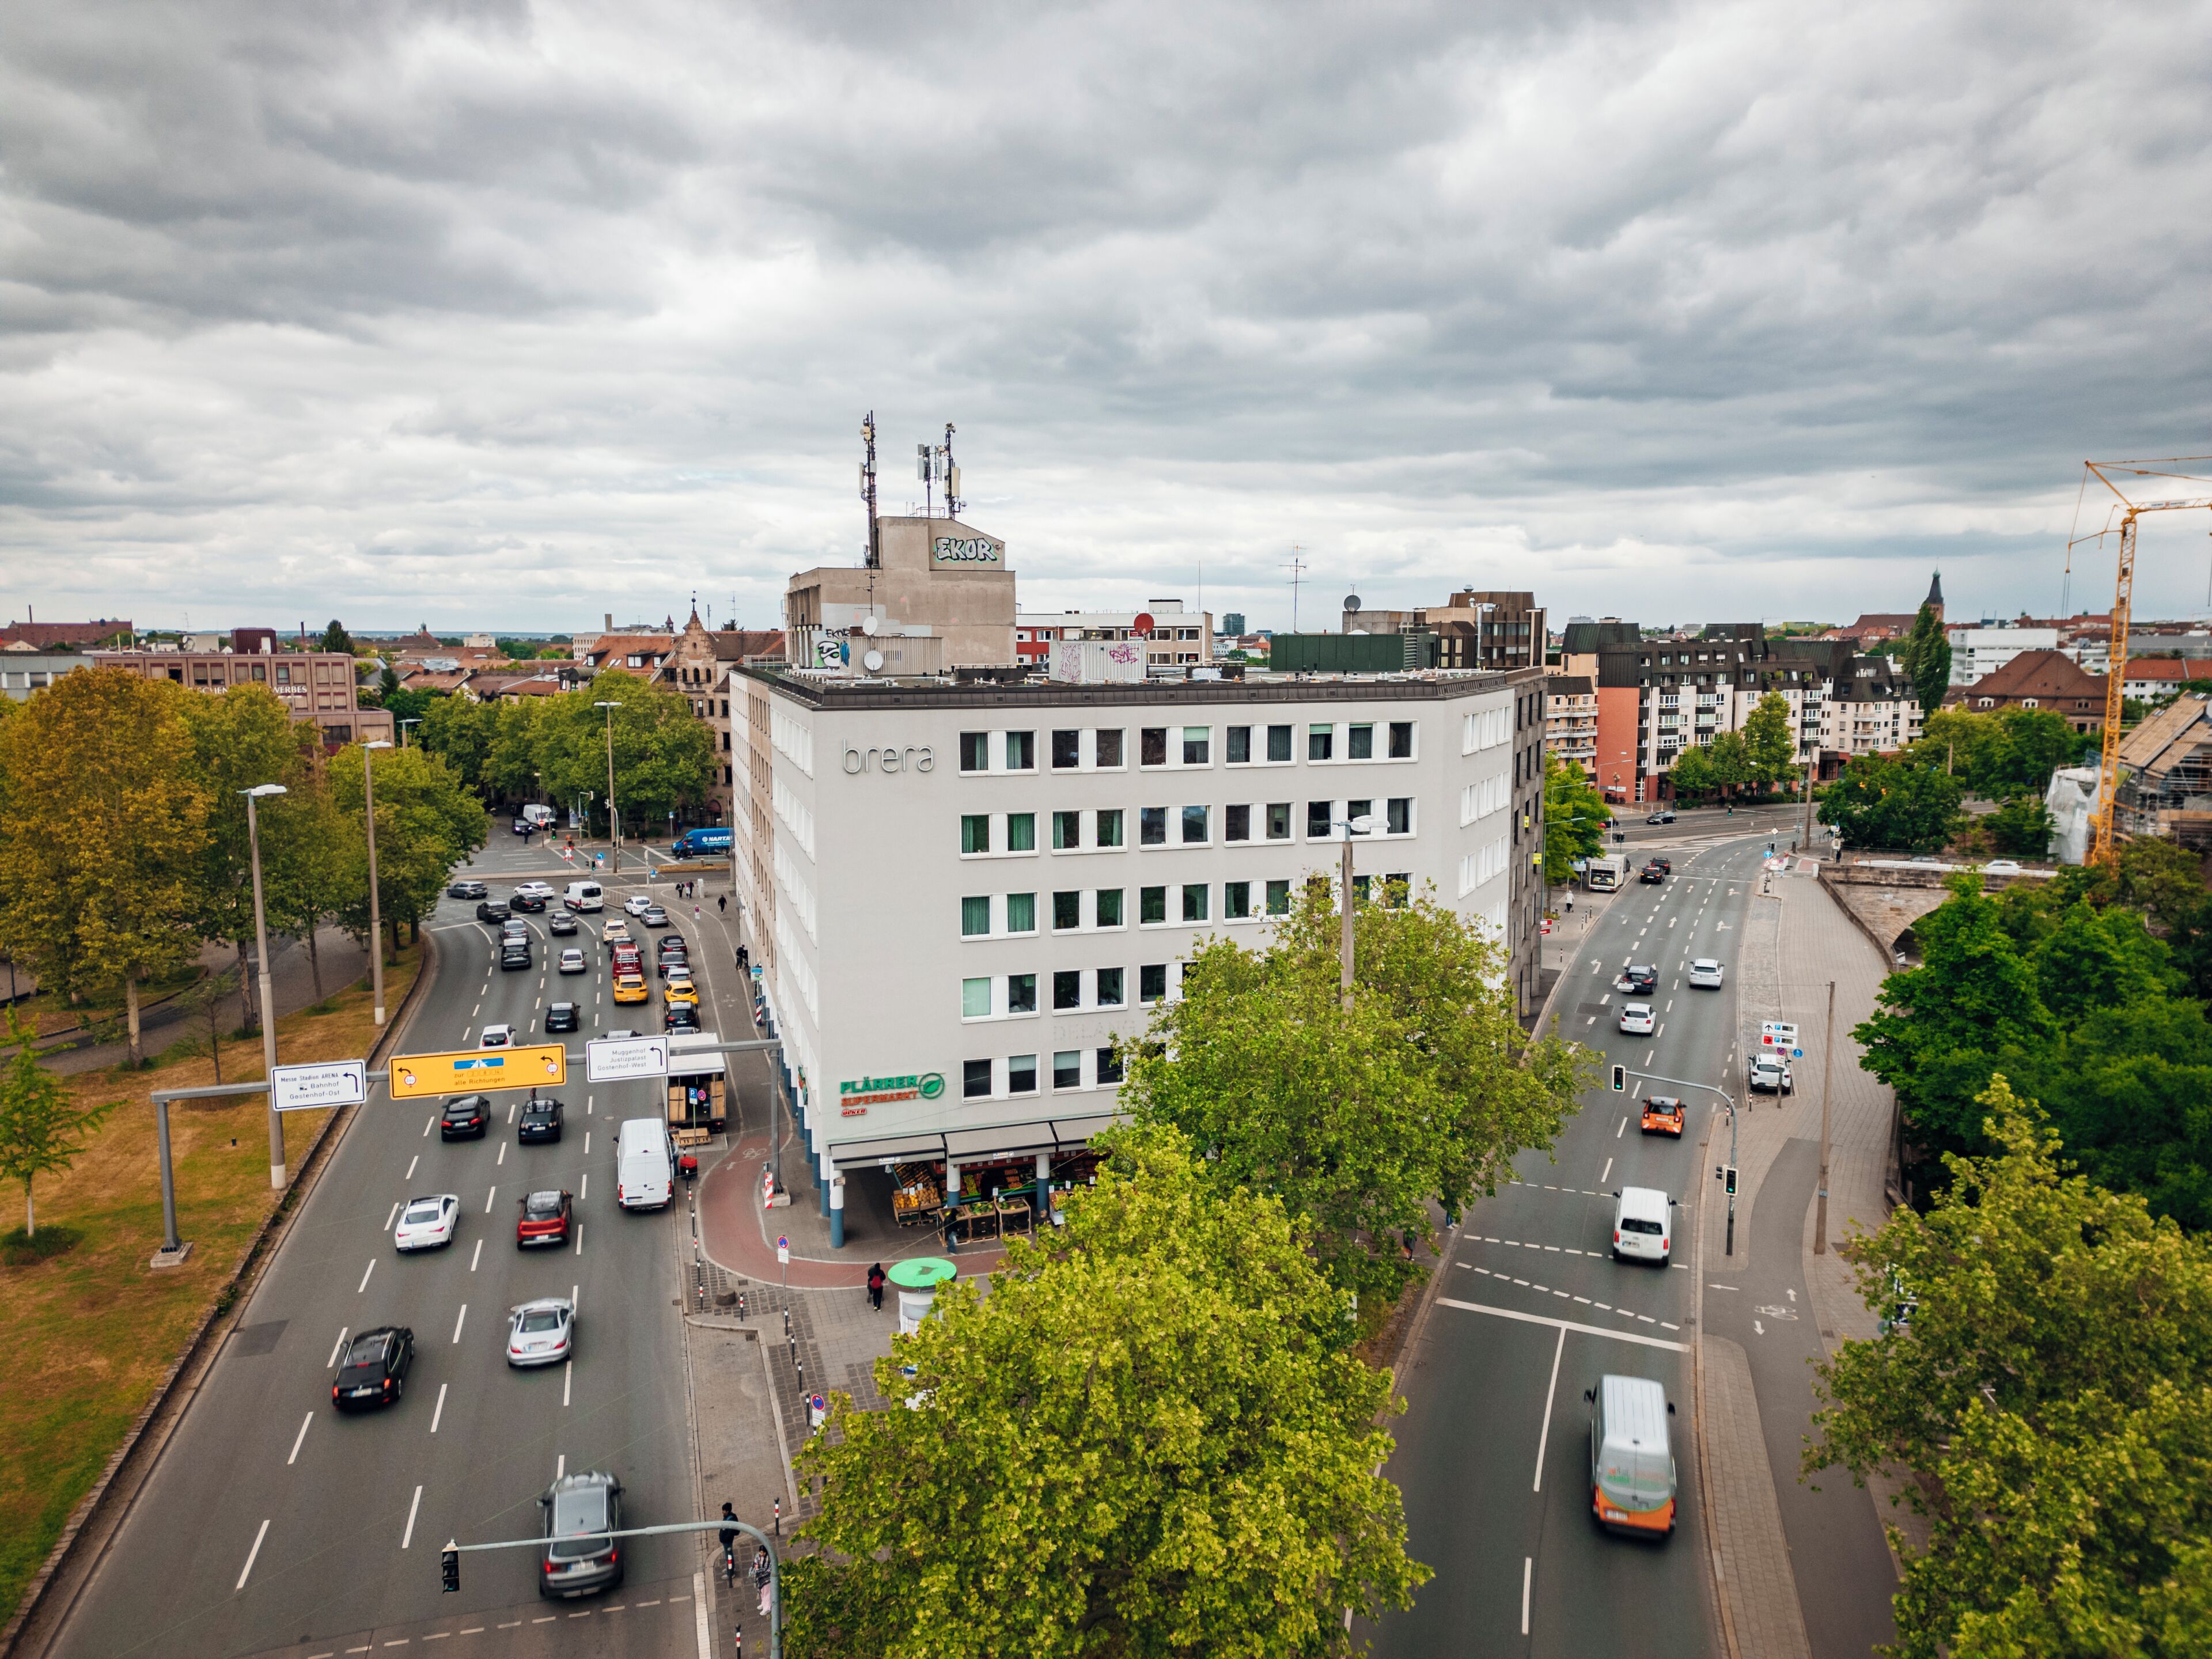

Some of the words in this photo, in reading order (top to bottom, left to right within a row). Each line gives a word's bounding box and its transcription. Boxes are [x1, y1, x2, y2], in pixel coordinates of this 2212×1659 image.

[935, 537, 997, 561] EKOR
[842, 738, 934, 774] brera
[612, 1048, 646, 1056] Muggenhof
[610, 1055, 646, 1063] Justizpalast
[597, 1062, 646, 1071] Gostenhof-West
[469, 1077, 505, 1085] Richtungen
[840, 1076, 918, 1094] PLÄRRER
[290, 1090, 340, 1100] Gostenhof-Ost
[841, 1090, 919, 1107] SUPERMARKT
